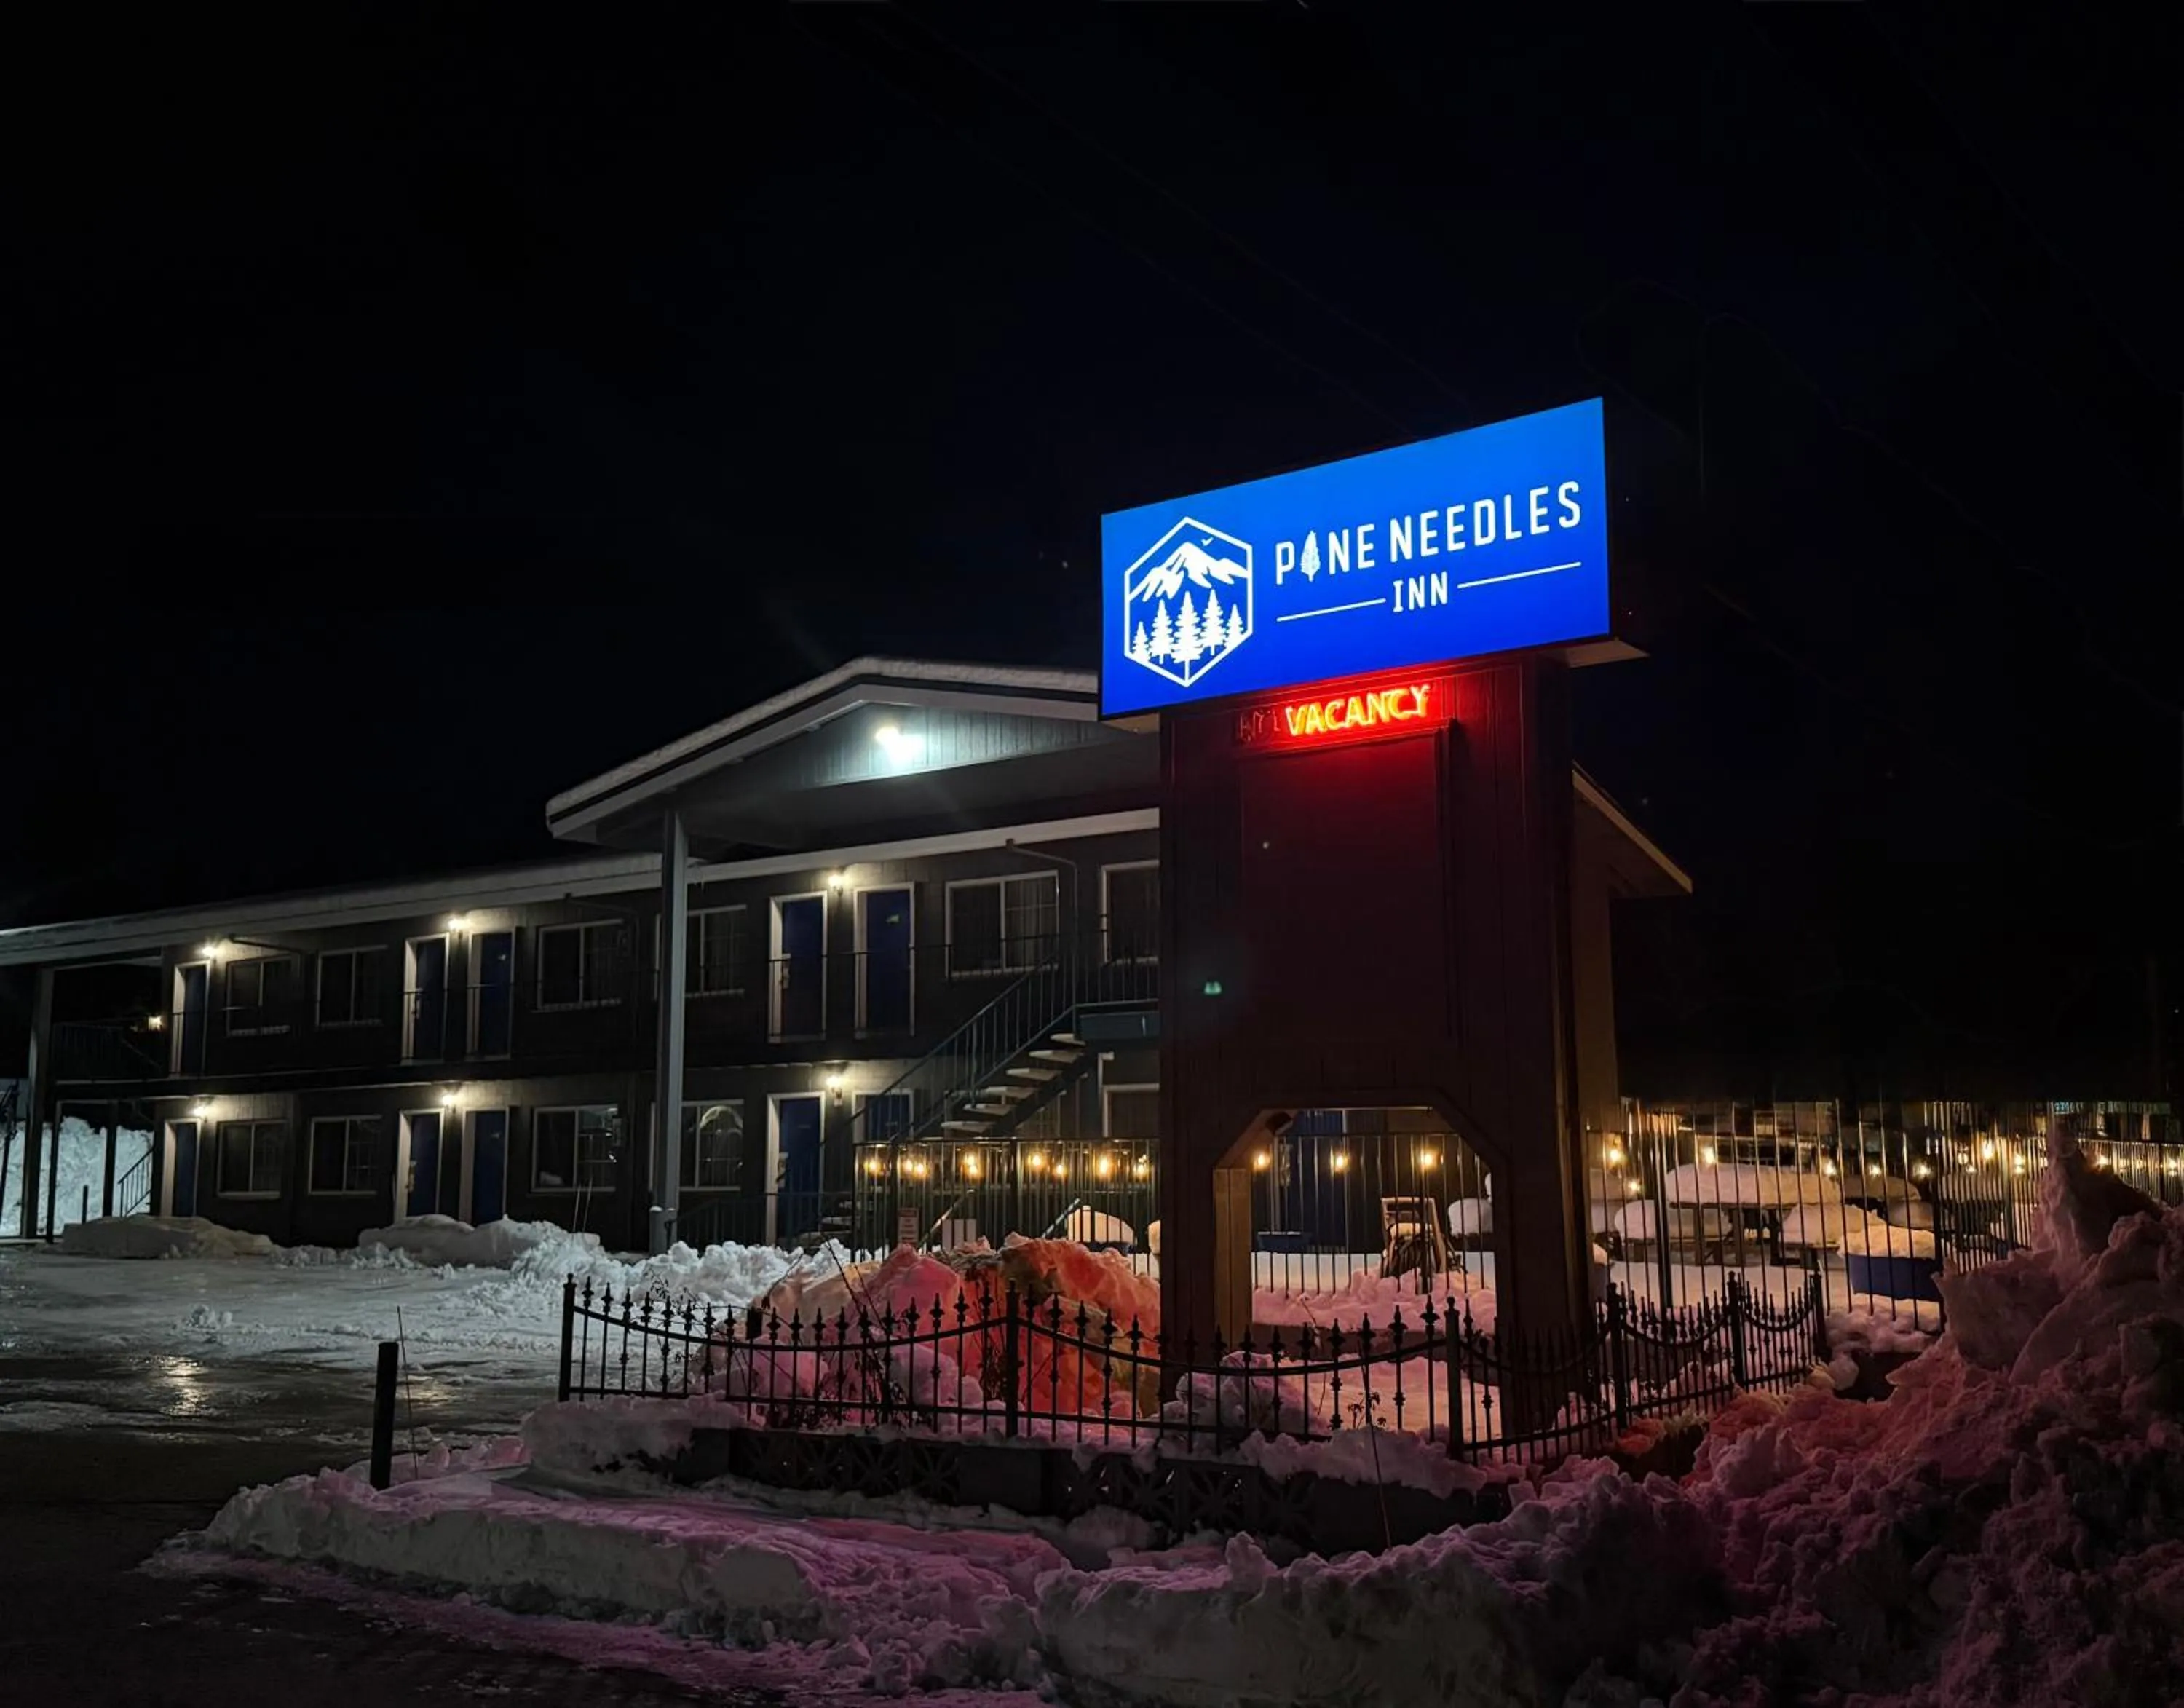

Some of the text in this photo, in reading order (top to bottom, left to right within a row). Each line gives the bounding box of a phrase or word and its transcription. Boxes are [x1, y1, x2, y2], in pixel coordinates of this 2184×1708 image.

[1390, 481, 1581, 563] NEEDLES
[1393, 572, 1448, 612] INN
[1285, 684, 1431, 737] VACANCY
